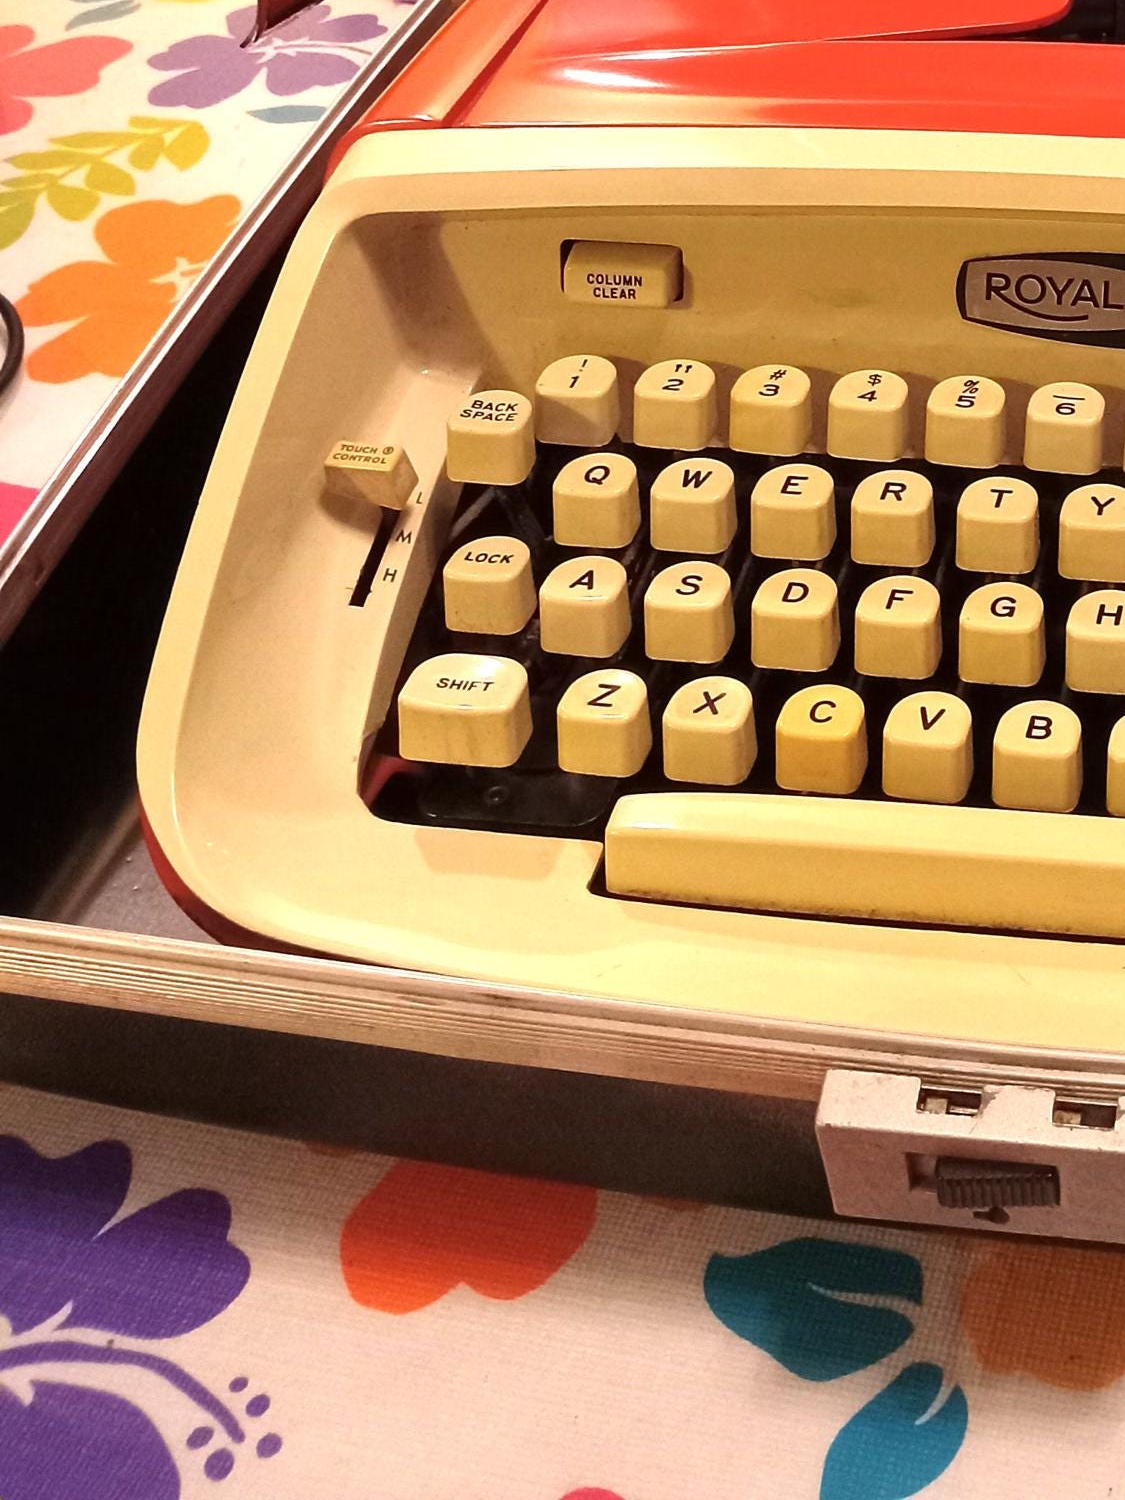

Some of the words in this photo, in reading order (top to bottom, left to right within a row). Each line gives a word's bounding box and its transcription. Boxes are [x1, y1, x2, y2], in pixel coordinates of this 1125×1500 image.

[586, 273, 643, 289] COLUMN
[592, 286, 637, 300] CLEAR
[983, 272, 1125, 323] ROYAL
[569, 375, 580, 389] 1
[769, 369, 787, 381] #
[867, 373, 883, 387] $
[662, 378, 684, 392] 2
[758, 383, 780, 397] 3
[962, 379, 980, 395] %
[857, 389, 878, 402] 4
[954, 394, 977, 409] 5
[469, 399, 519, 414] BACK
[1055, 402, 1076, 416] 6
[459, 409, 518, 422] SPACE
[340, 444, 378, 454] TOUCH
[333, 453, 387, 465] CONTROL
[584, 465, 611, 486] Q
[682, 469, 713, 489] W
[780, 475, 809, 495] E
[879, 481, 907, 502] R
[416, 492, 423, 504] L
[990, 488, 1014, 509] T
[1090, 496, 1116, 516] Y
[396, 530, 412, 544] M
[463, 551, 515, 564] LOCK
[383, 568, 398, 582] H
[568, 569, 594, 591] A
[675, 574, 703, 596] S
[781, 581, 810, 603] D
[885, 588, 914, 610] F
[990, 596, 1017, 618] G
[1095, 603, 1124, 627] H
[436, 677, 495, 692] SHIFT
[586, 683, 622, 708] Z
[692, 691, 727, 716] X
[809, 700, 837, 724] C
[920, 706, 946, 731] V
[1025, 715, 1053, 740] B
